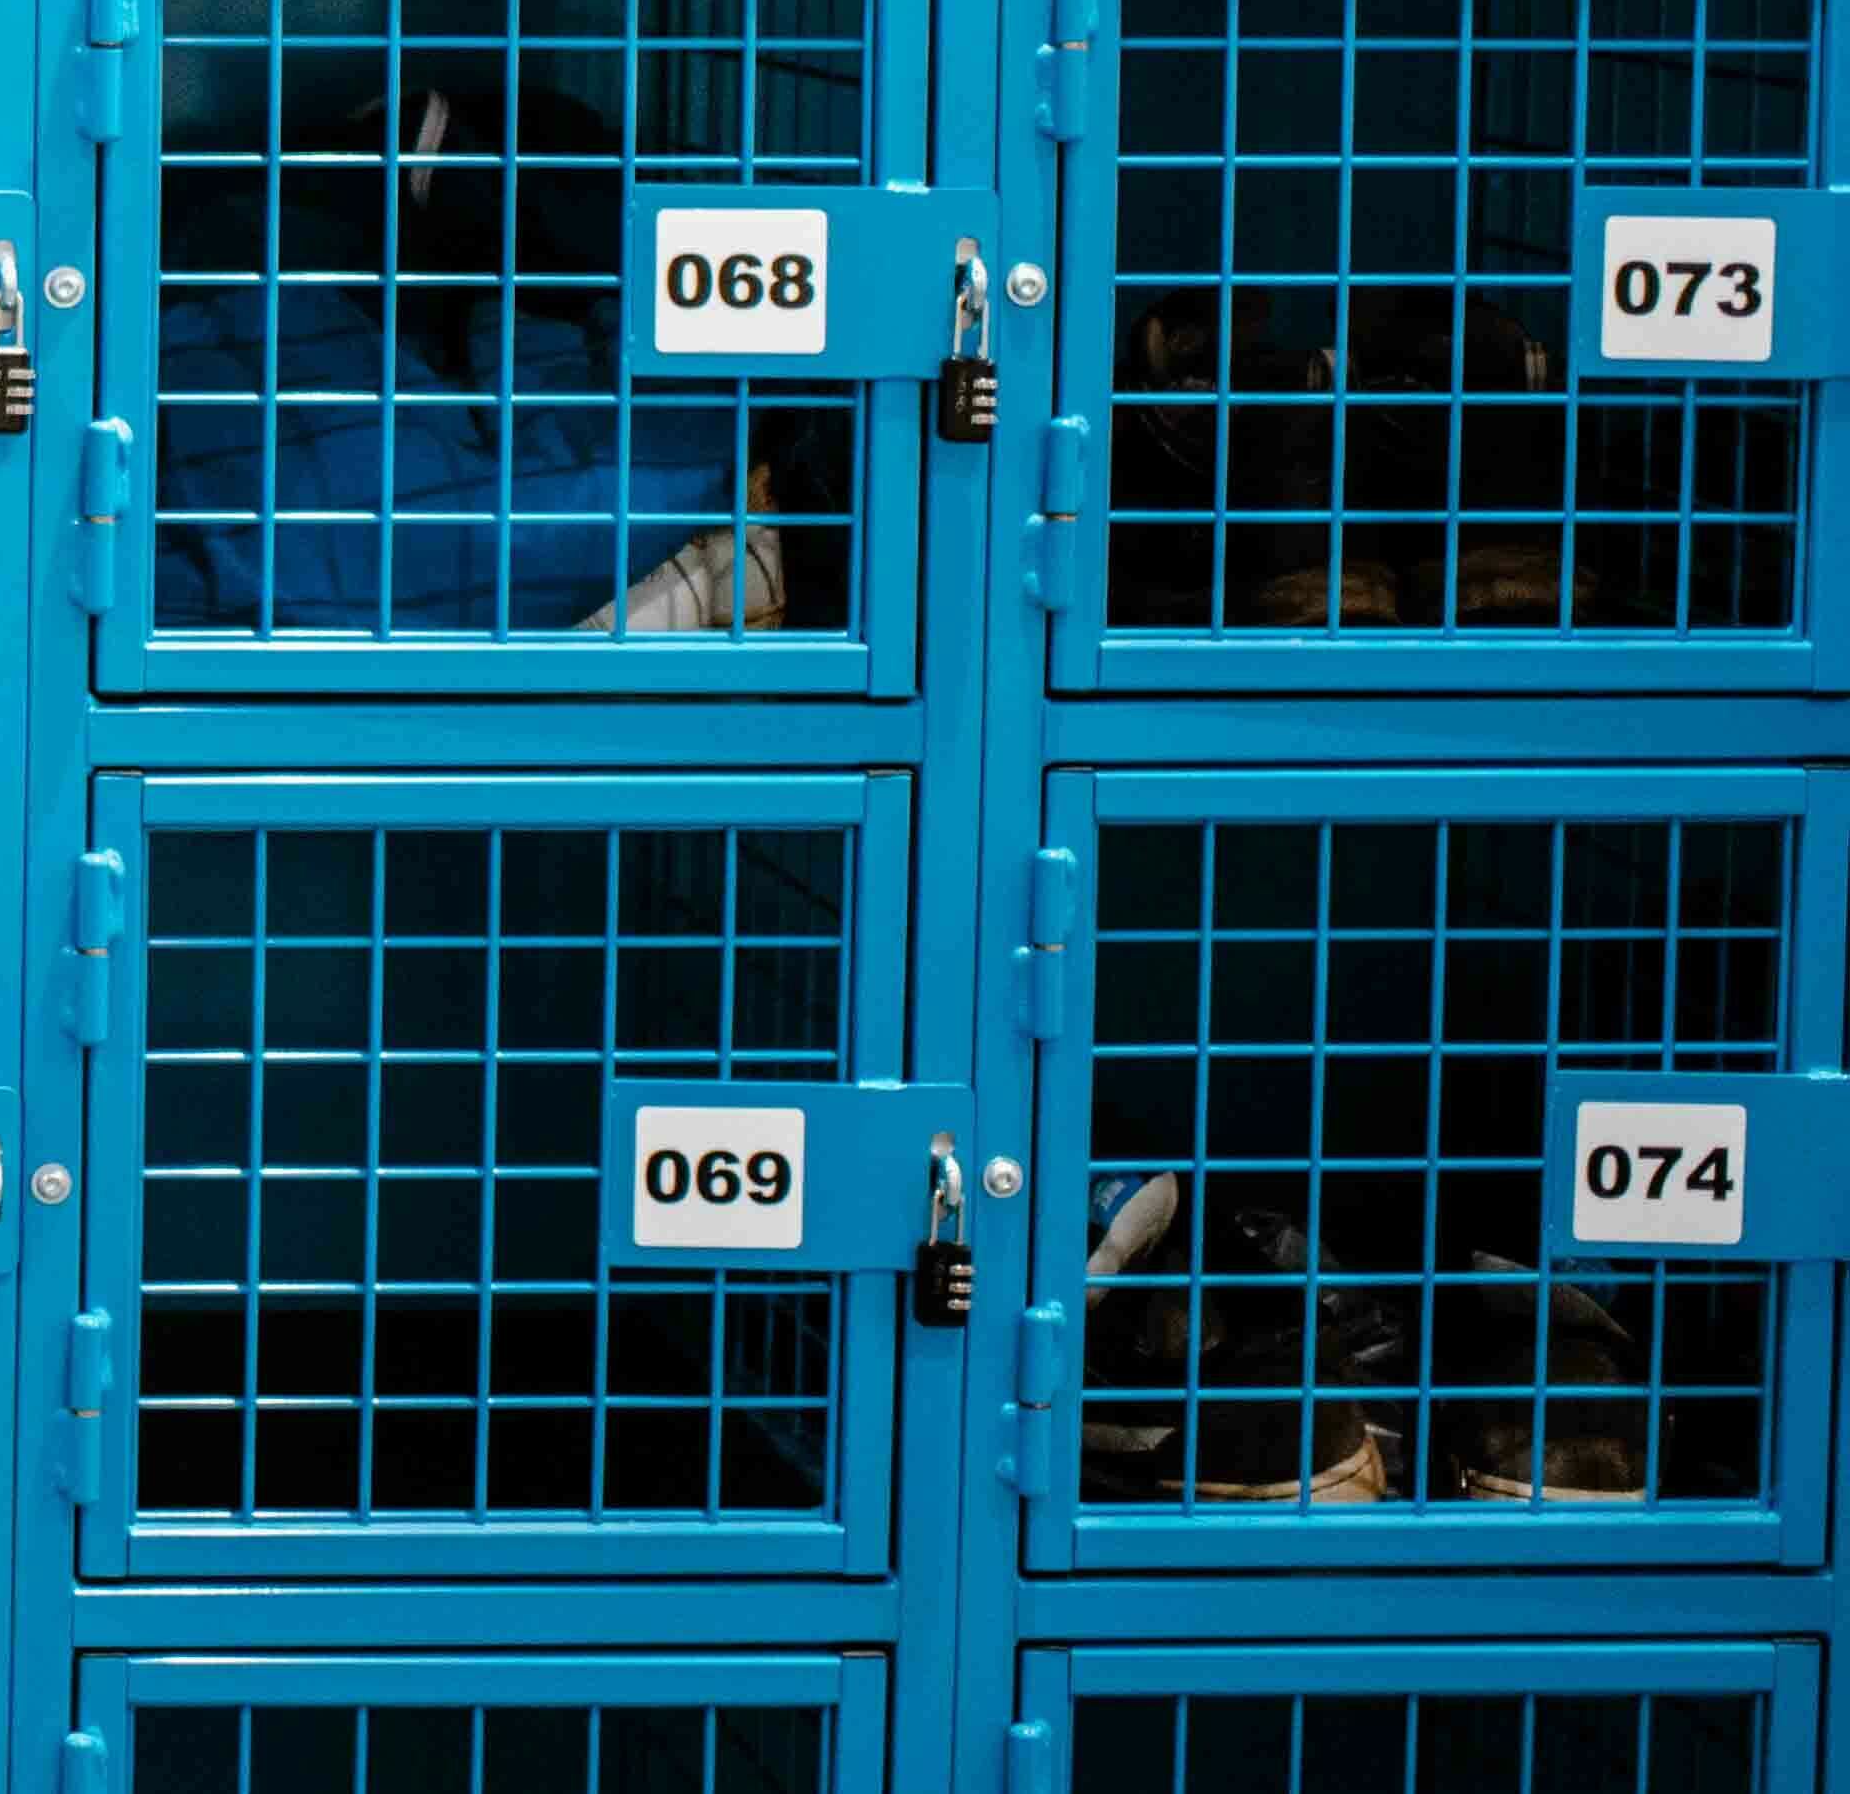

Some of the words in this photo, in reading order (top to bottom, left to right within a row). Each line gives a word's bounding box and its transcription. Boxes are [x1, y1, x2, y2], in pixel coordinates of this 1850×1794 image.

[666, 252, 815, 310] 068
[1613, 259, 1763, 319] 073
[644, 1148, 792, 1206] 069
[1585, 1143, 1735, 1202] 074
